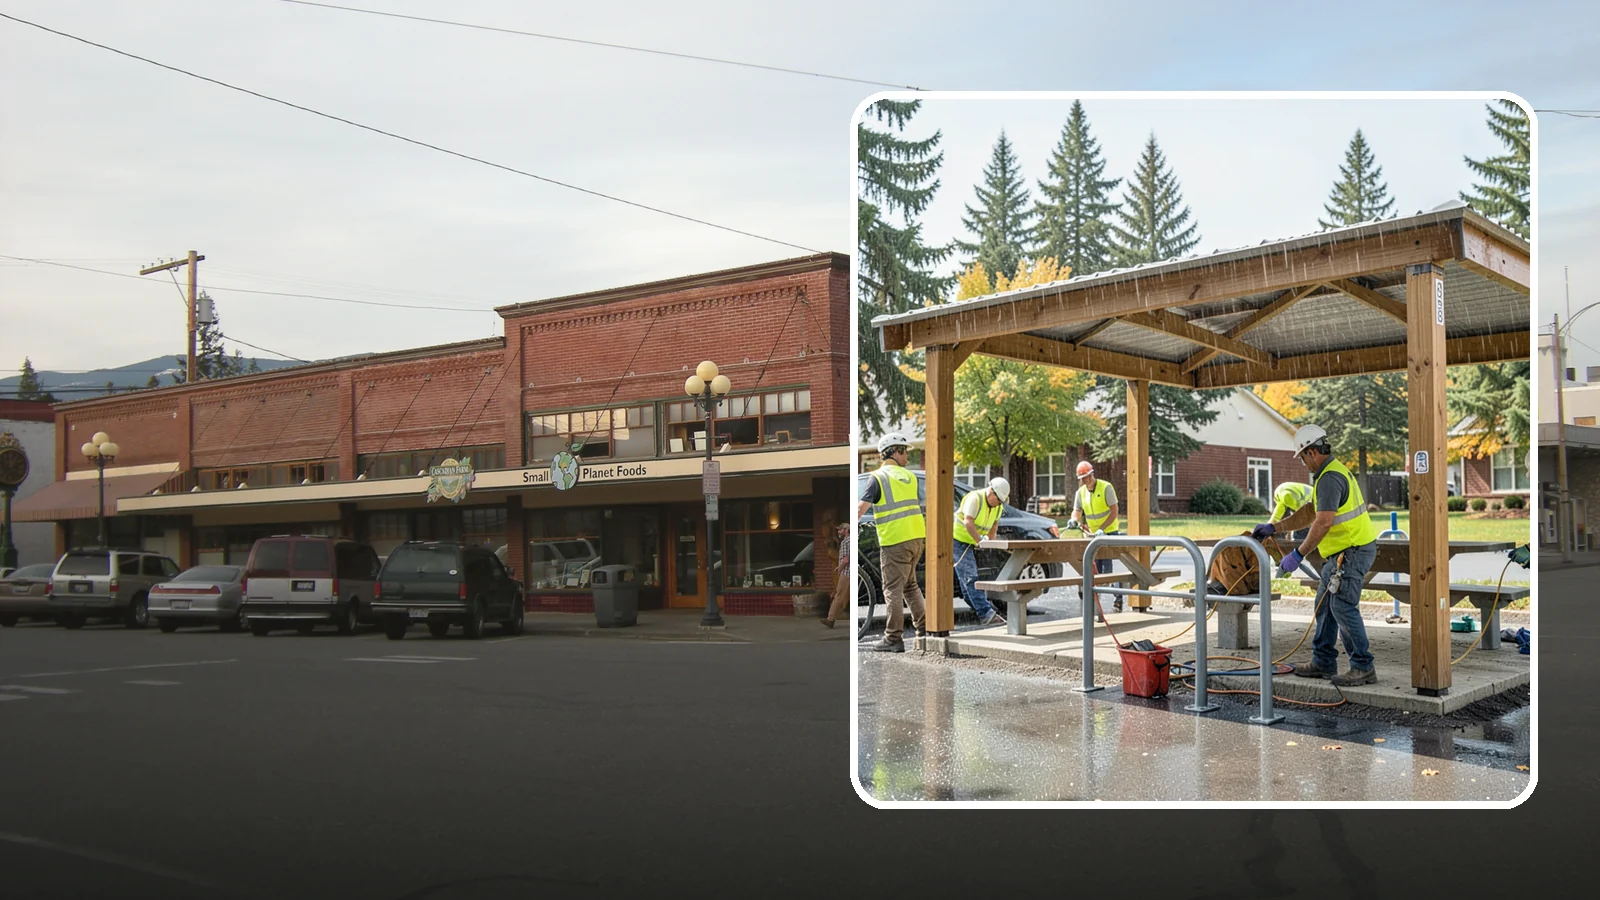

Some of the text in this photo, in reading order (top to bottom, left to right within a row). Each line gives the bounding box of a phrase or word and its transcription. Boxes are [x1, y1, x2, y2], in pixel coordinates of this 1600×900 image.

[522, 464, 647, 483] Small Planet Foods
